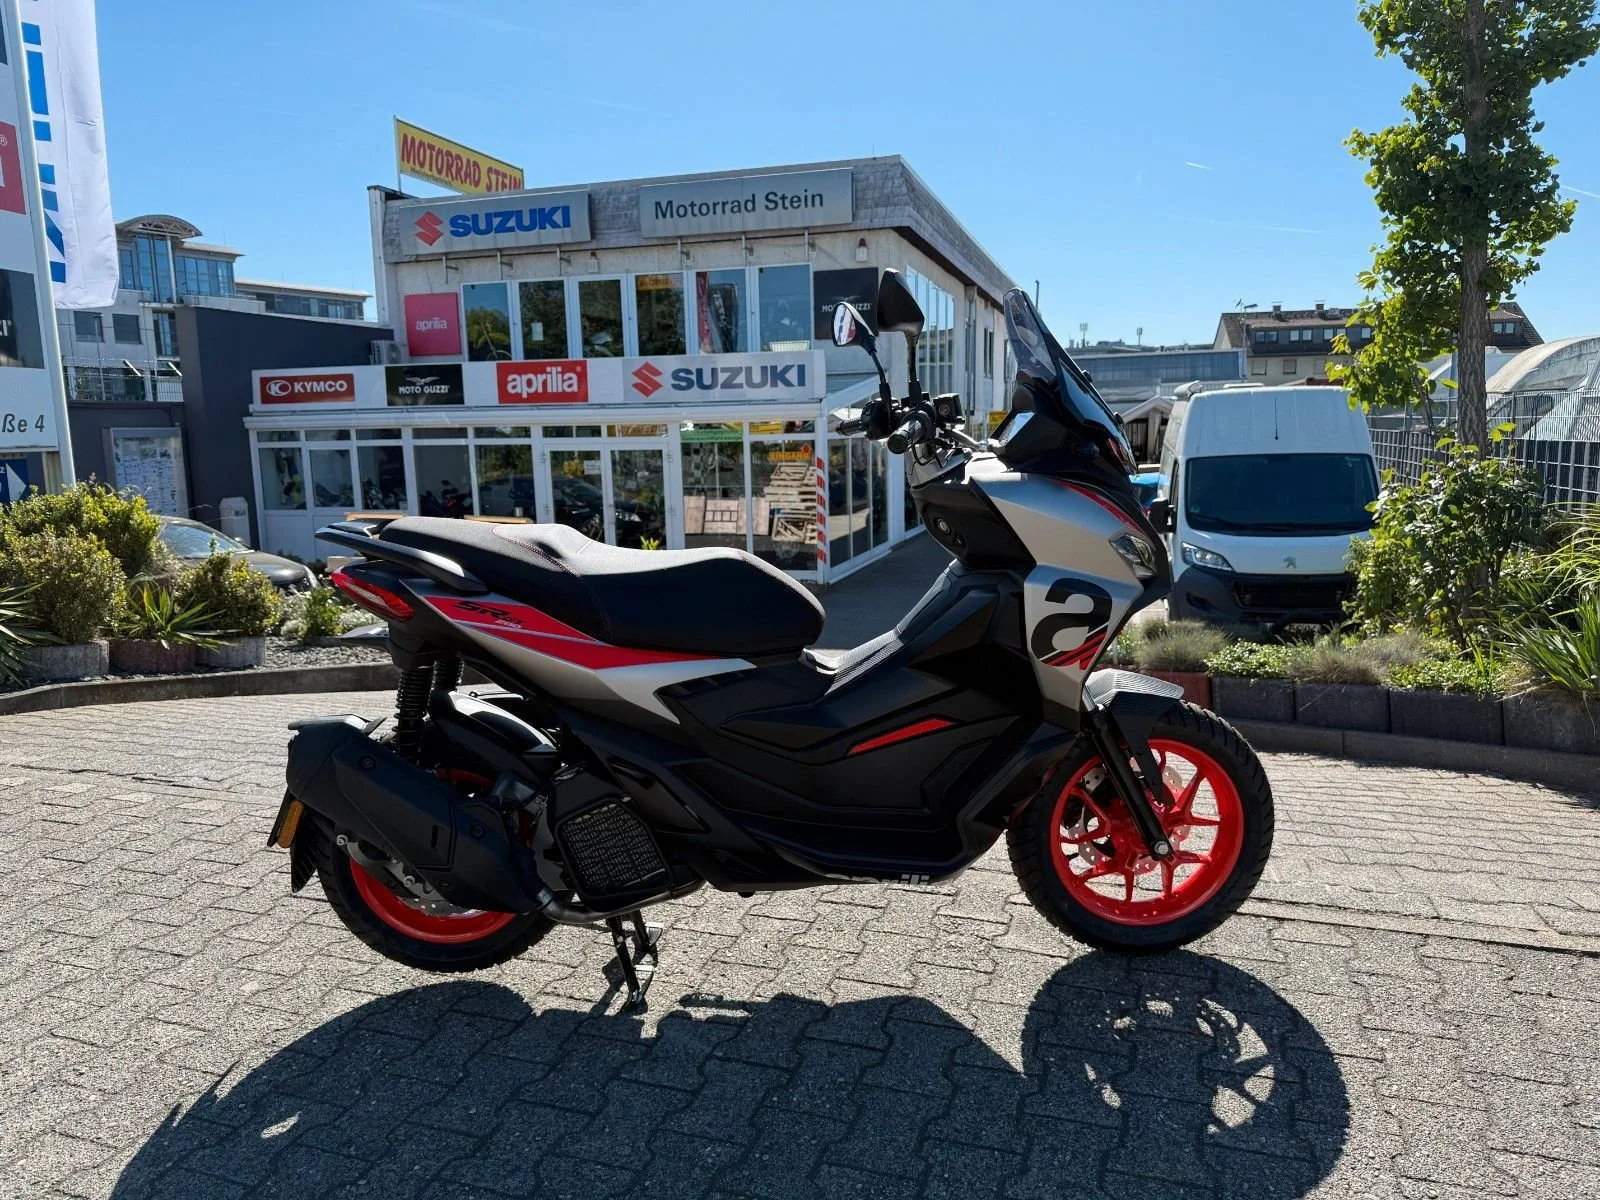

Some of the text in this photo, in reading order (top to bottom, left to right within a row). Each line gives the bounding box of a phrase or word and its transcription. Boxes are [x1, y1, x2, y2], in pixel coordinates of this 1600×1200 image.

[401, 133, 482, 188] MOTORRAD
[654, 188, 824, 220] Motorrad Stein
[450, 205, 571, 237] SUZUKI
[416, 317, 448, 332] aprilia
[294, 380, 348, 393] KYMCO
[399, 384, 449, 394] MOTO GUZZI
[506, 366, 578, 397] aprilia
[671, 364, 806, 391] SUZUKI
[34, 414, 45, 433] 4
